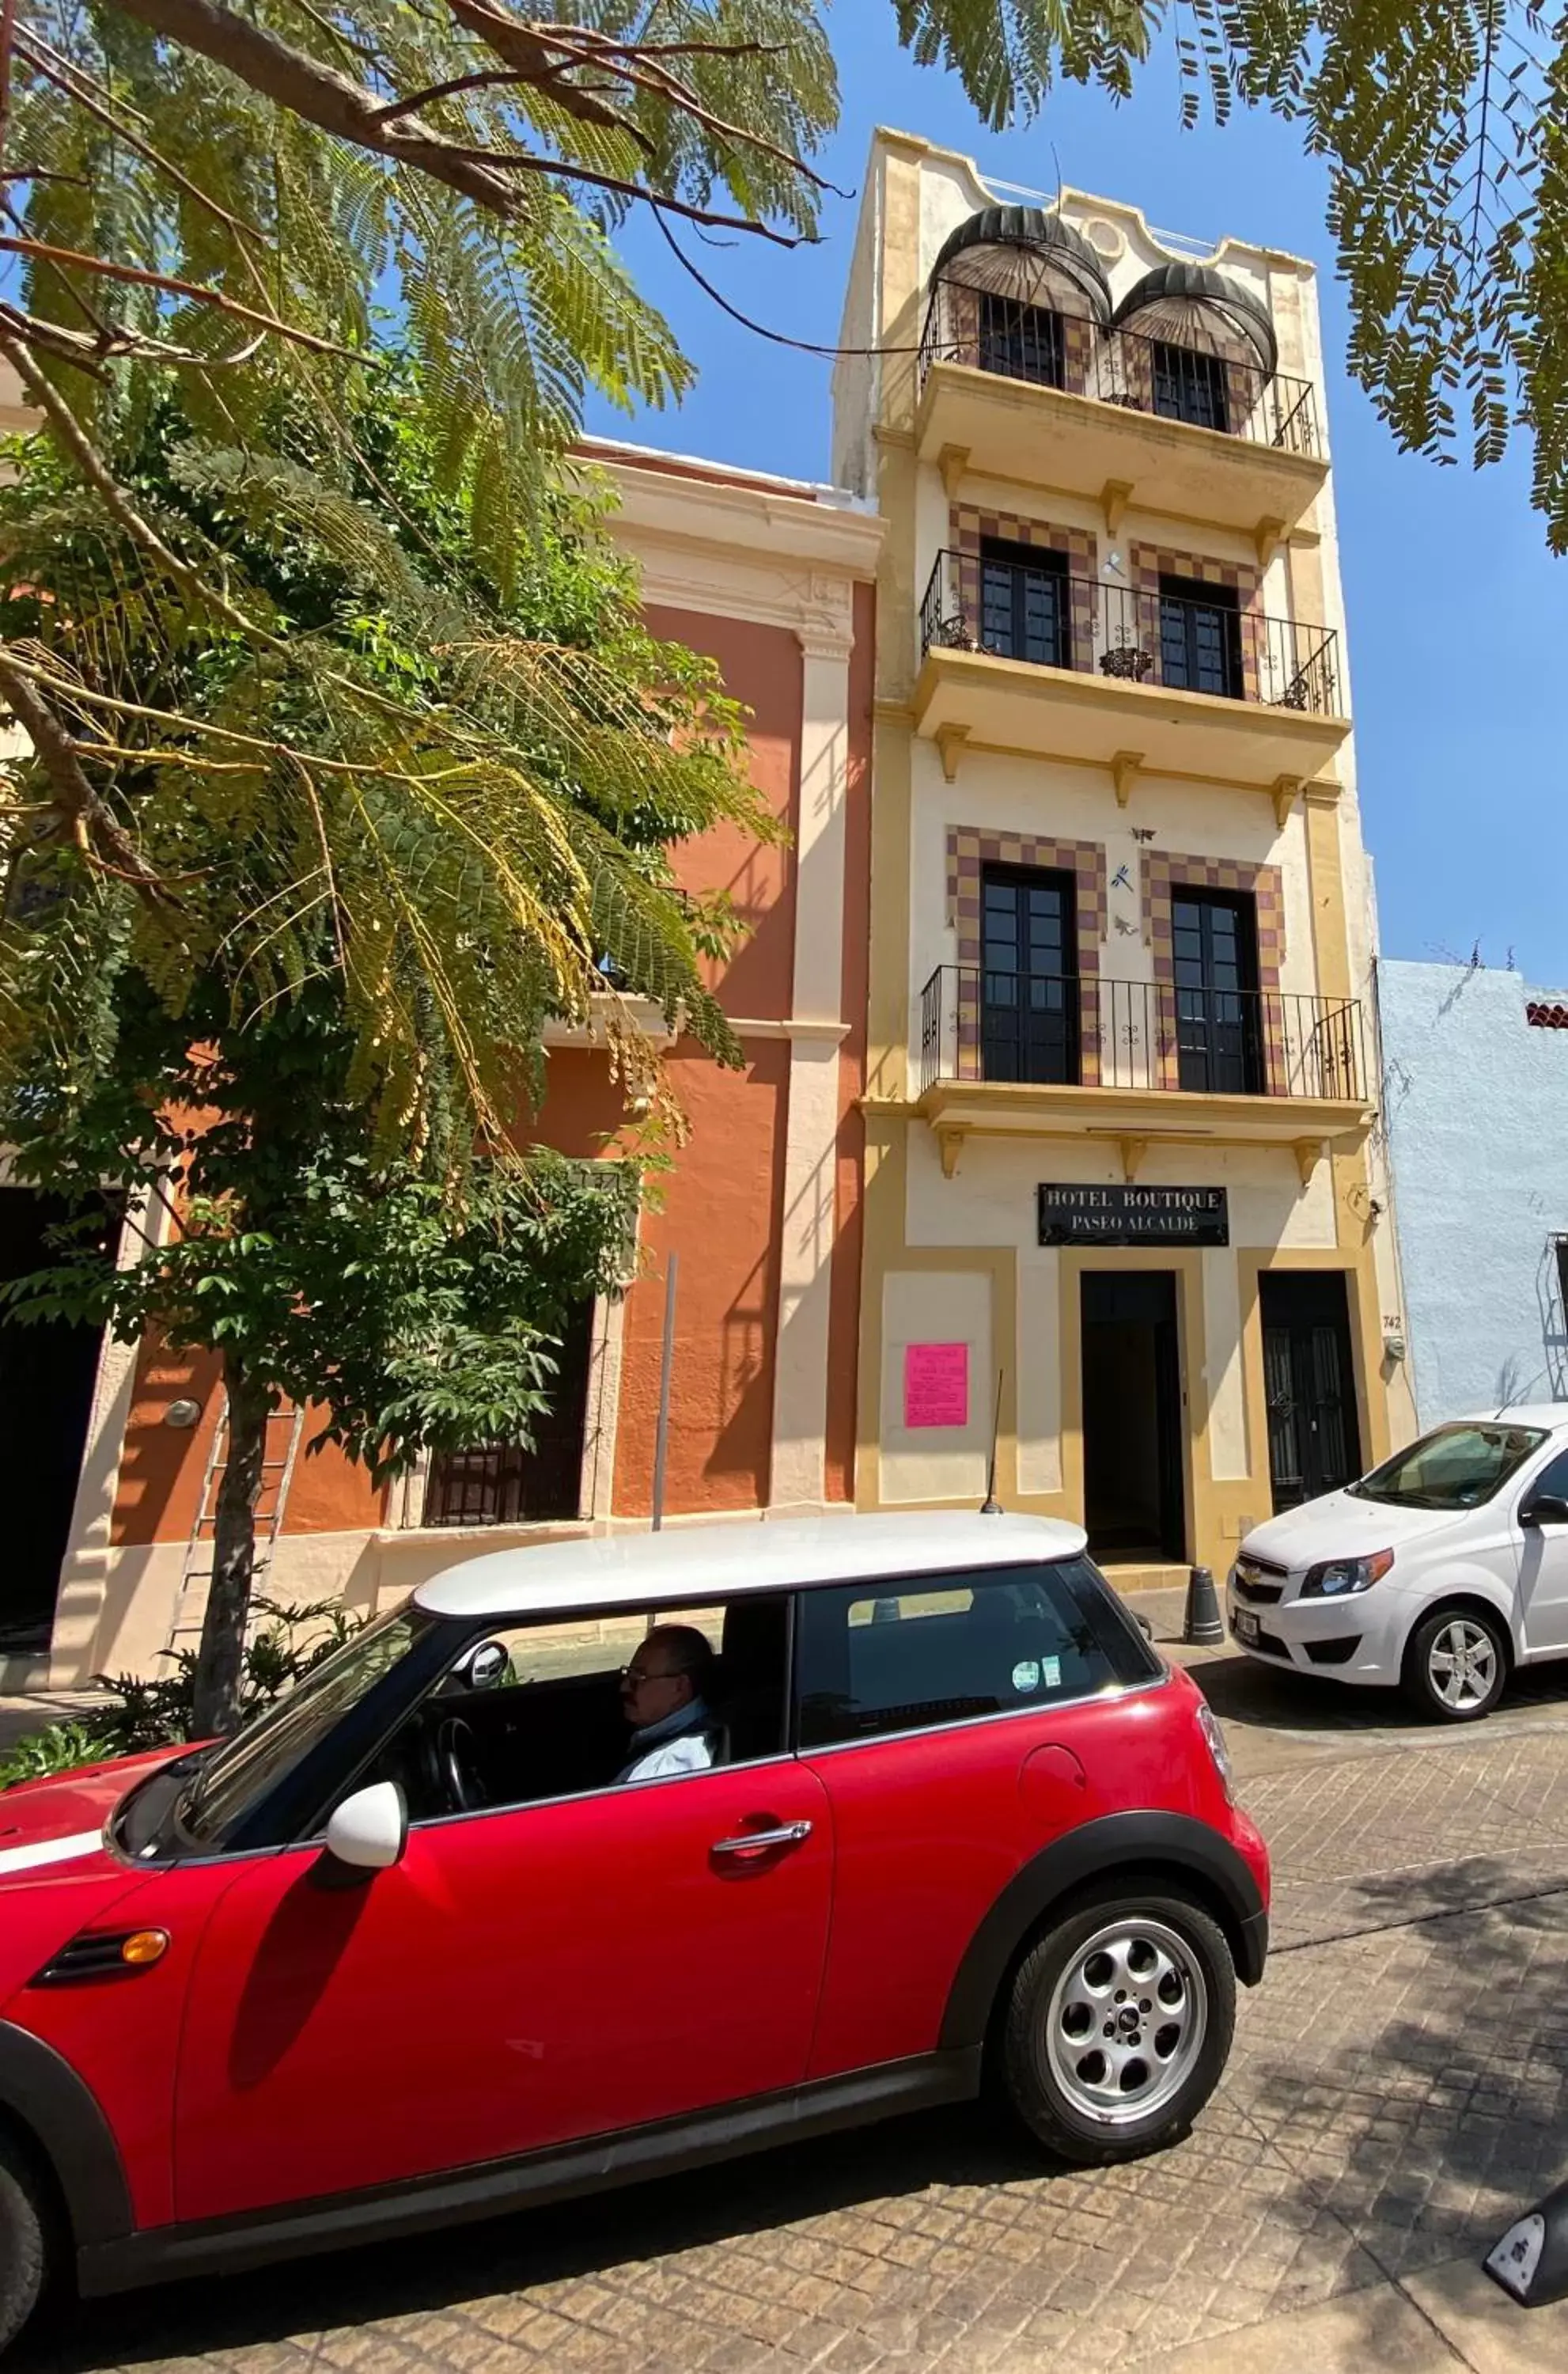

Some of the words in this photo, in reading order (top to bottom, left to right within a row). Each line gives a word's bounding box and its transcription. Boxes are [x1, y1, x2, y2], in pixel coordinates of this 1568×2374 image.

[1047, 1190, 1113, 1207] HOTEL
[1123, 1191, 1219, 1212] BOUTIQUE
[1072, 1215, 1123, 1231] PASEO
[1129, 1215, 1199, 1231] ALCALDE
